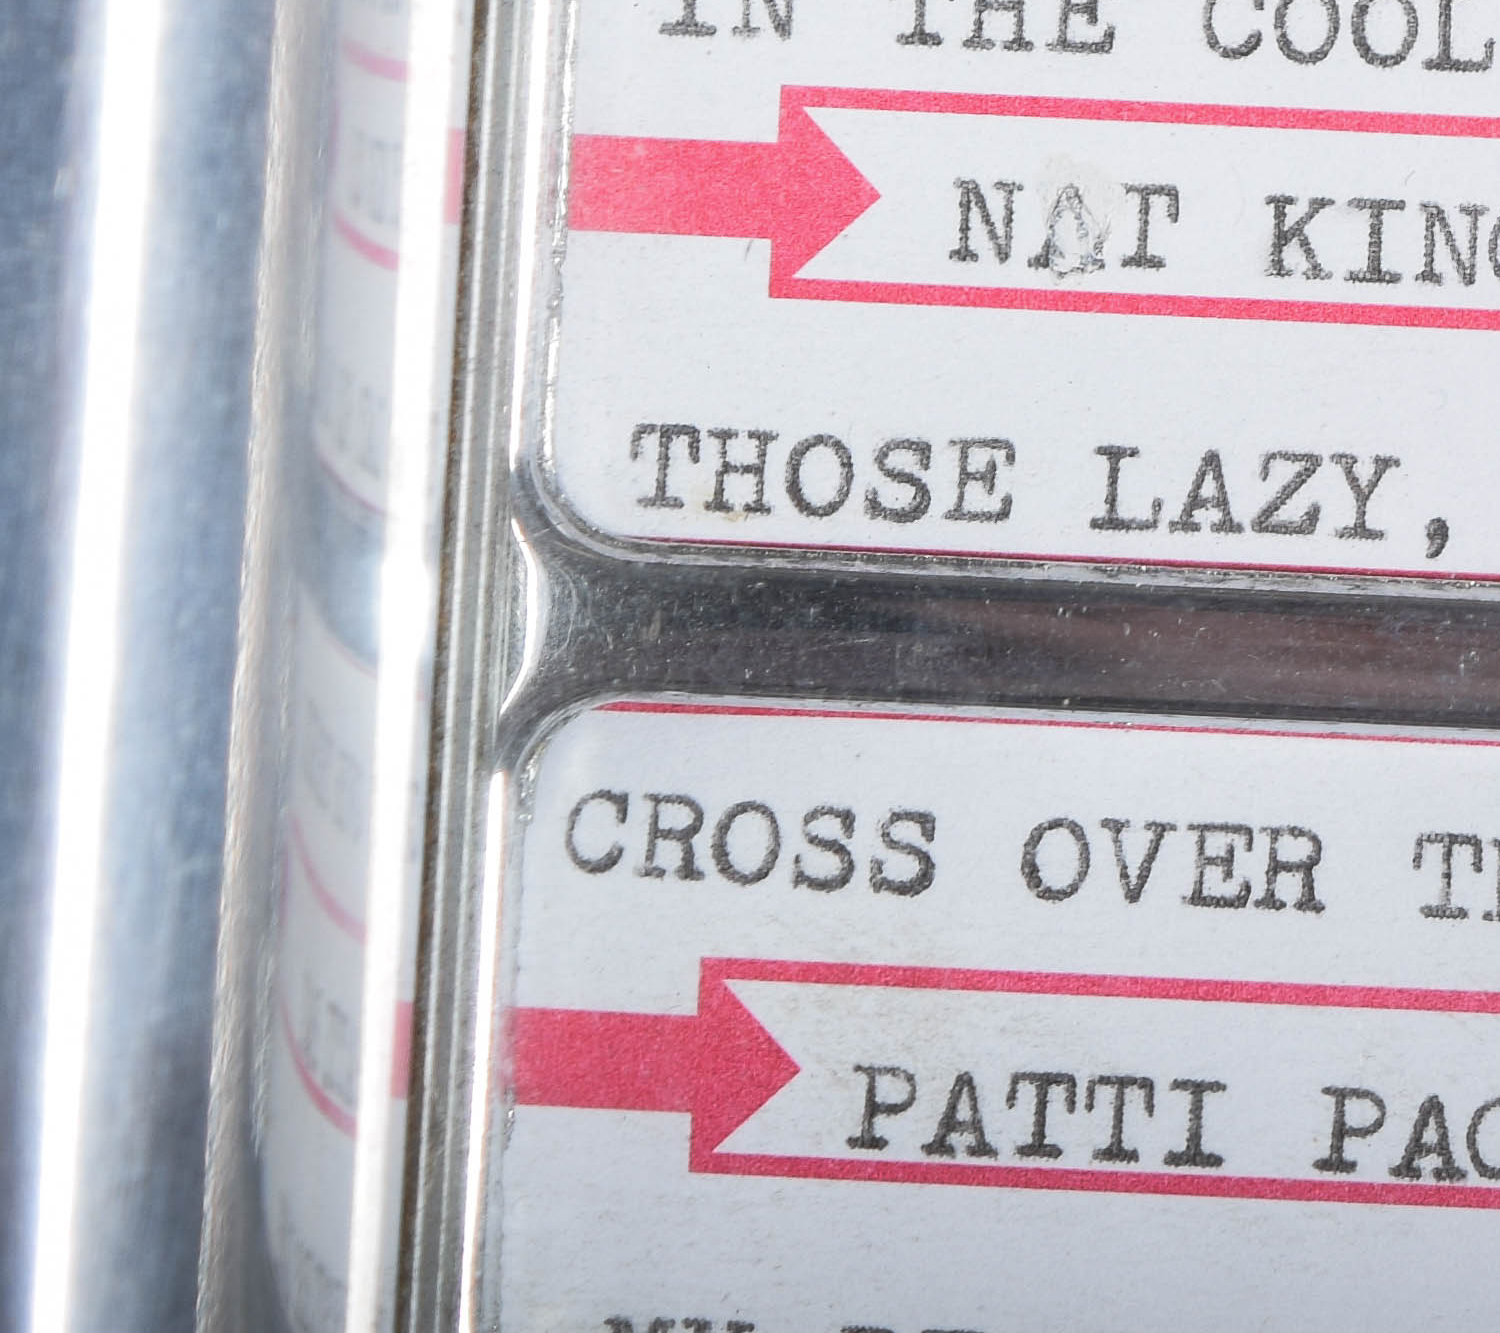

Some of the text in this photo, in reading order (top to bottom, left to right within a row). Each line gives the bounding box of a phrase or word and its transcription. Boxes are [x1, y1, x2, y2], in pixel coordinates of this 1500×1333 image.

[947, 177, 1181, 275] NAT
[629, 422, 1017, 526] THOSE
[1090, 443, 1451, 563] LAZY,
[563, 788, 938, 900] CROSS
[1018, 816, 1328, 917] OVER
[844, 1062, 1229, 1171] PATTI
